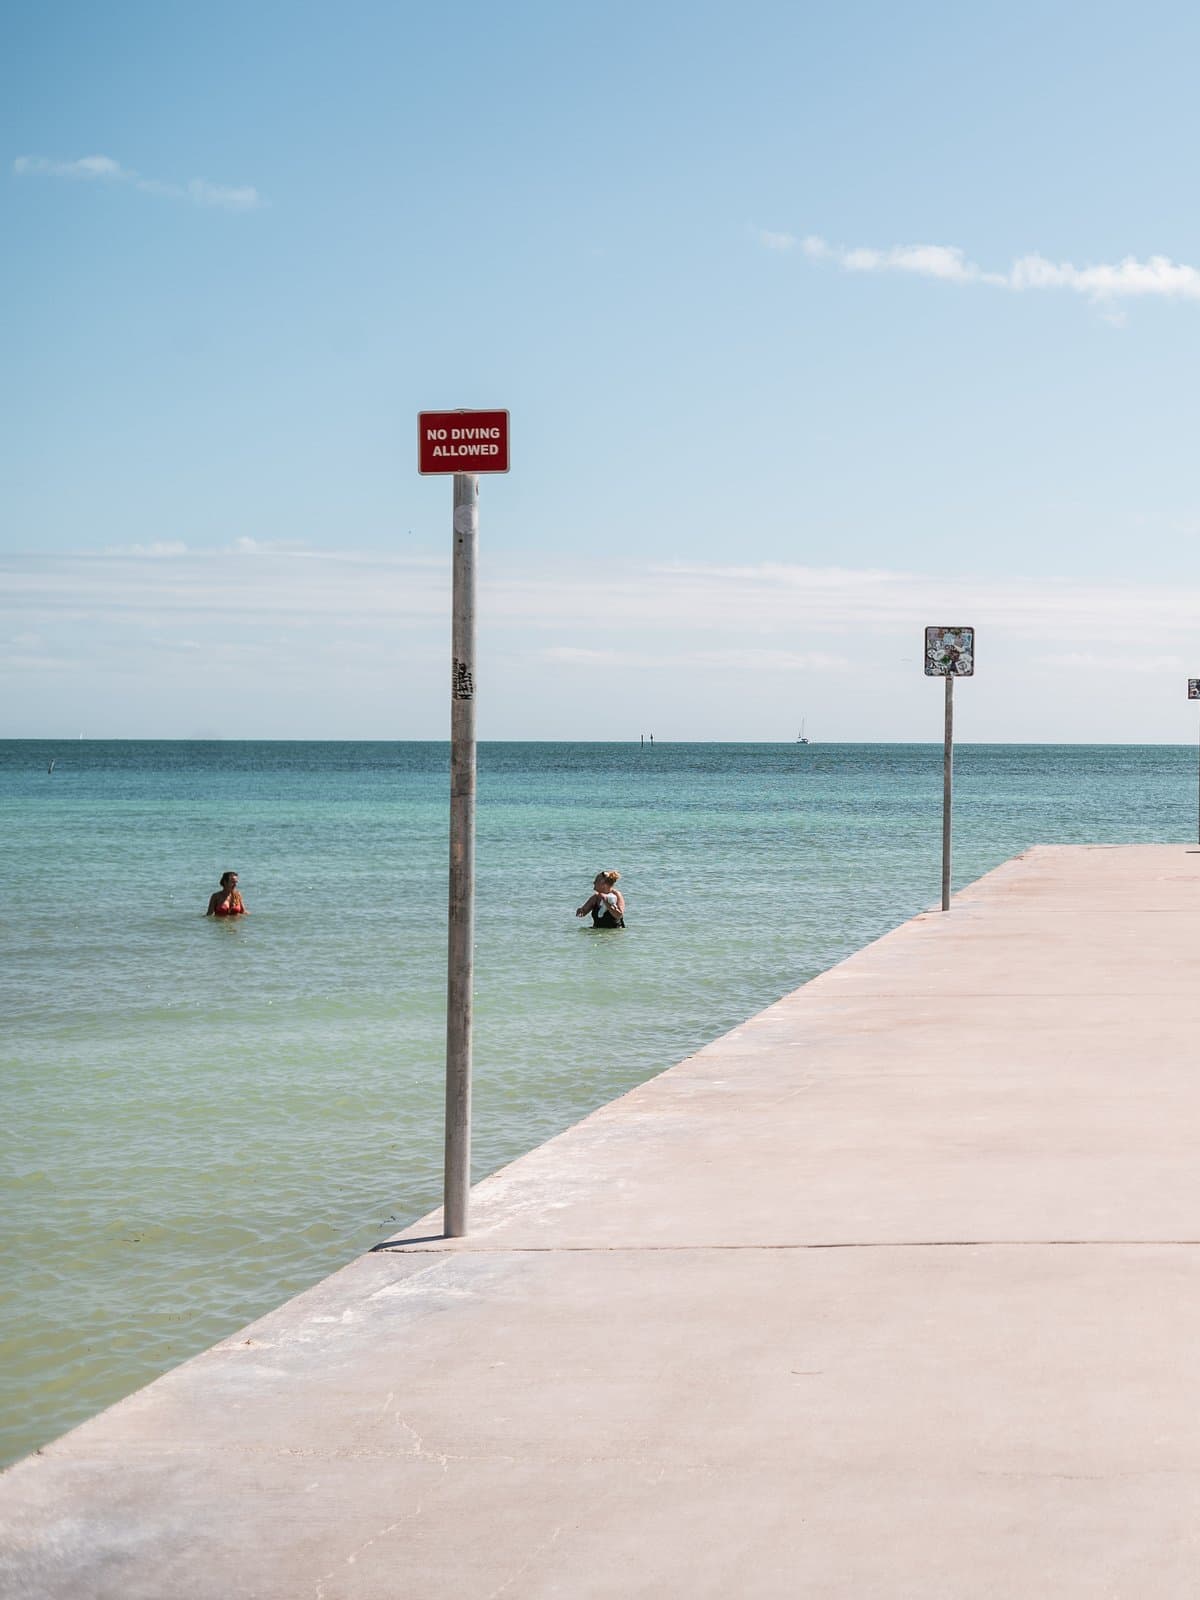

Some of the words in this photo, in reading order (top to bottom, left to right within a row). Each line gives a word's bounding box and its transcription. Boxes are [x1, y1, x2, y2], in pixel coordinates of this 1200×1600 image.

[427, 429, 447, 440] NO
[451, 428, 500, 440] DIVING
[432, 444, 499, 457] ALLOWED
